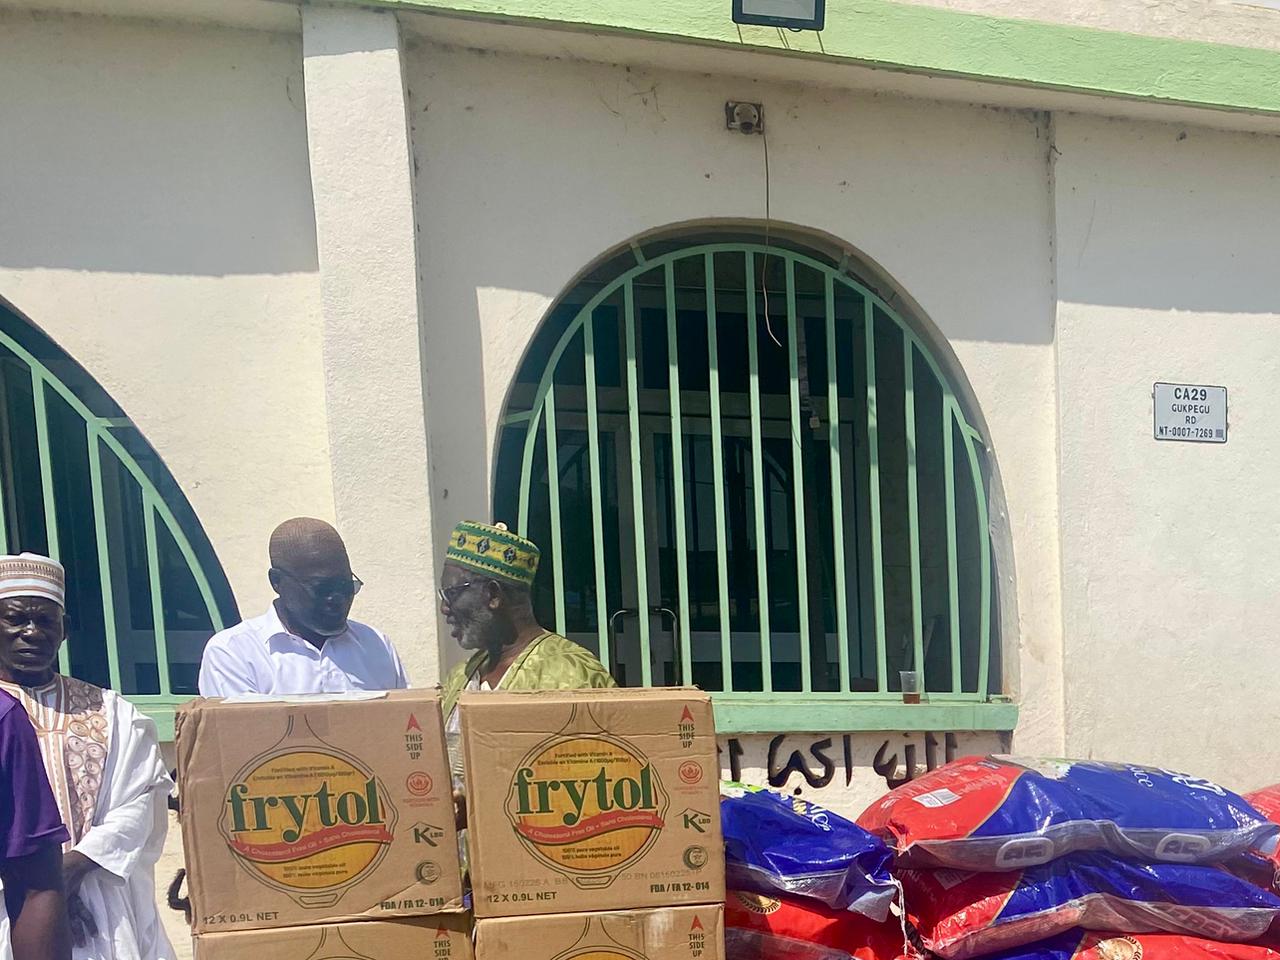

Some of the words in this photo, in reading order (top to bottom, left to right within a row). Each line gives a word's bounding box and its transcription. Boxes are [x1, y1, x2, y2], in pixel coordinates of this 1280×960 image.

[1174, 388, 1207, 401] CA29
[1171, 404, 1210, 414] GUKPEGU
[1185, 416, 1197, 424] RD
[678, 723, 695, 731] THIS
[405, 734, 423, 742] THIS
[679, 732, 695, 740] SIDE
[406, 743, 423, 751] SIDE
[410, 752, 421, 760] UP
[514, 762, 656, 825] frytol
[227, 775, 383, 842] frytol
[683, 814, 705, 833] K
[414, 827, 438, 847] K
[650, 885, 665, 893] FDA
[672, 883, 681, 892] FA
[488, 894, 499, 902] 12
[501, 894, 510, 902] X
[511, 893, 534, 902] 0.9L
[536, 892, 557, 900] NET
[203, 916, 216, 925] 12
[218, 915, 227, 924] X
[230, 914, 253, 923] 0.9L
[256, 911, 279, 921] NET
[688, 933, 705, 941] THIS
[434, 940, 451, 948] THIS
[434, 949, 451, 957] SIDE
